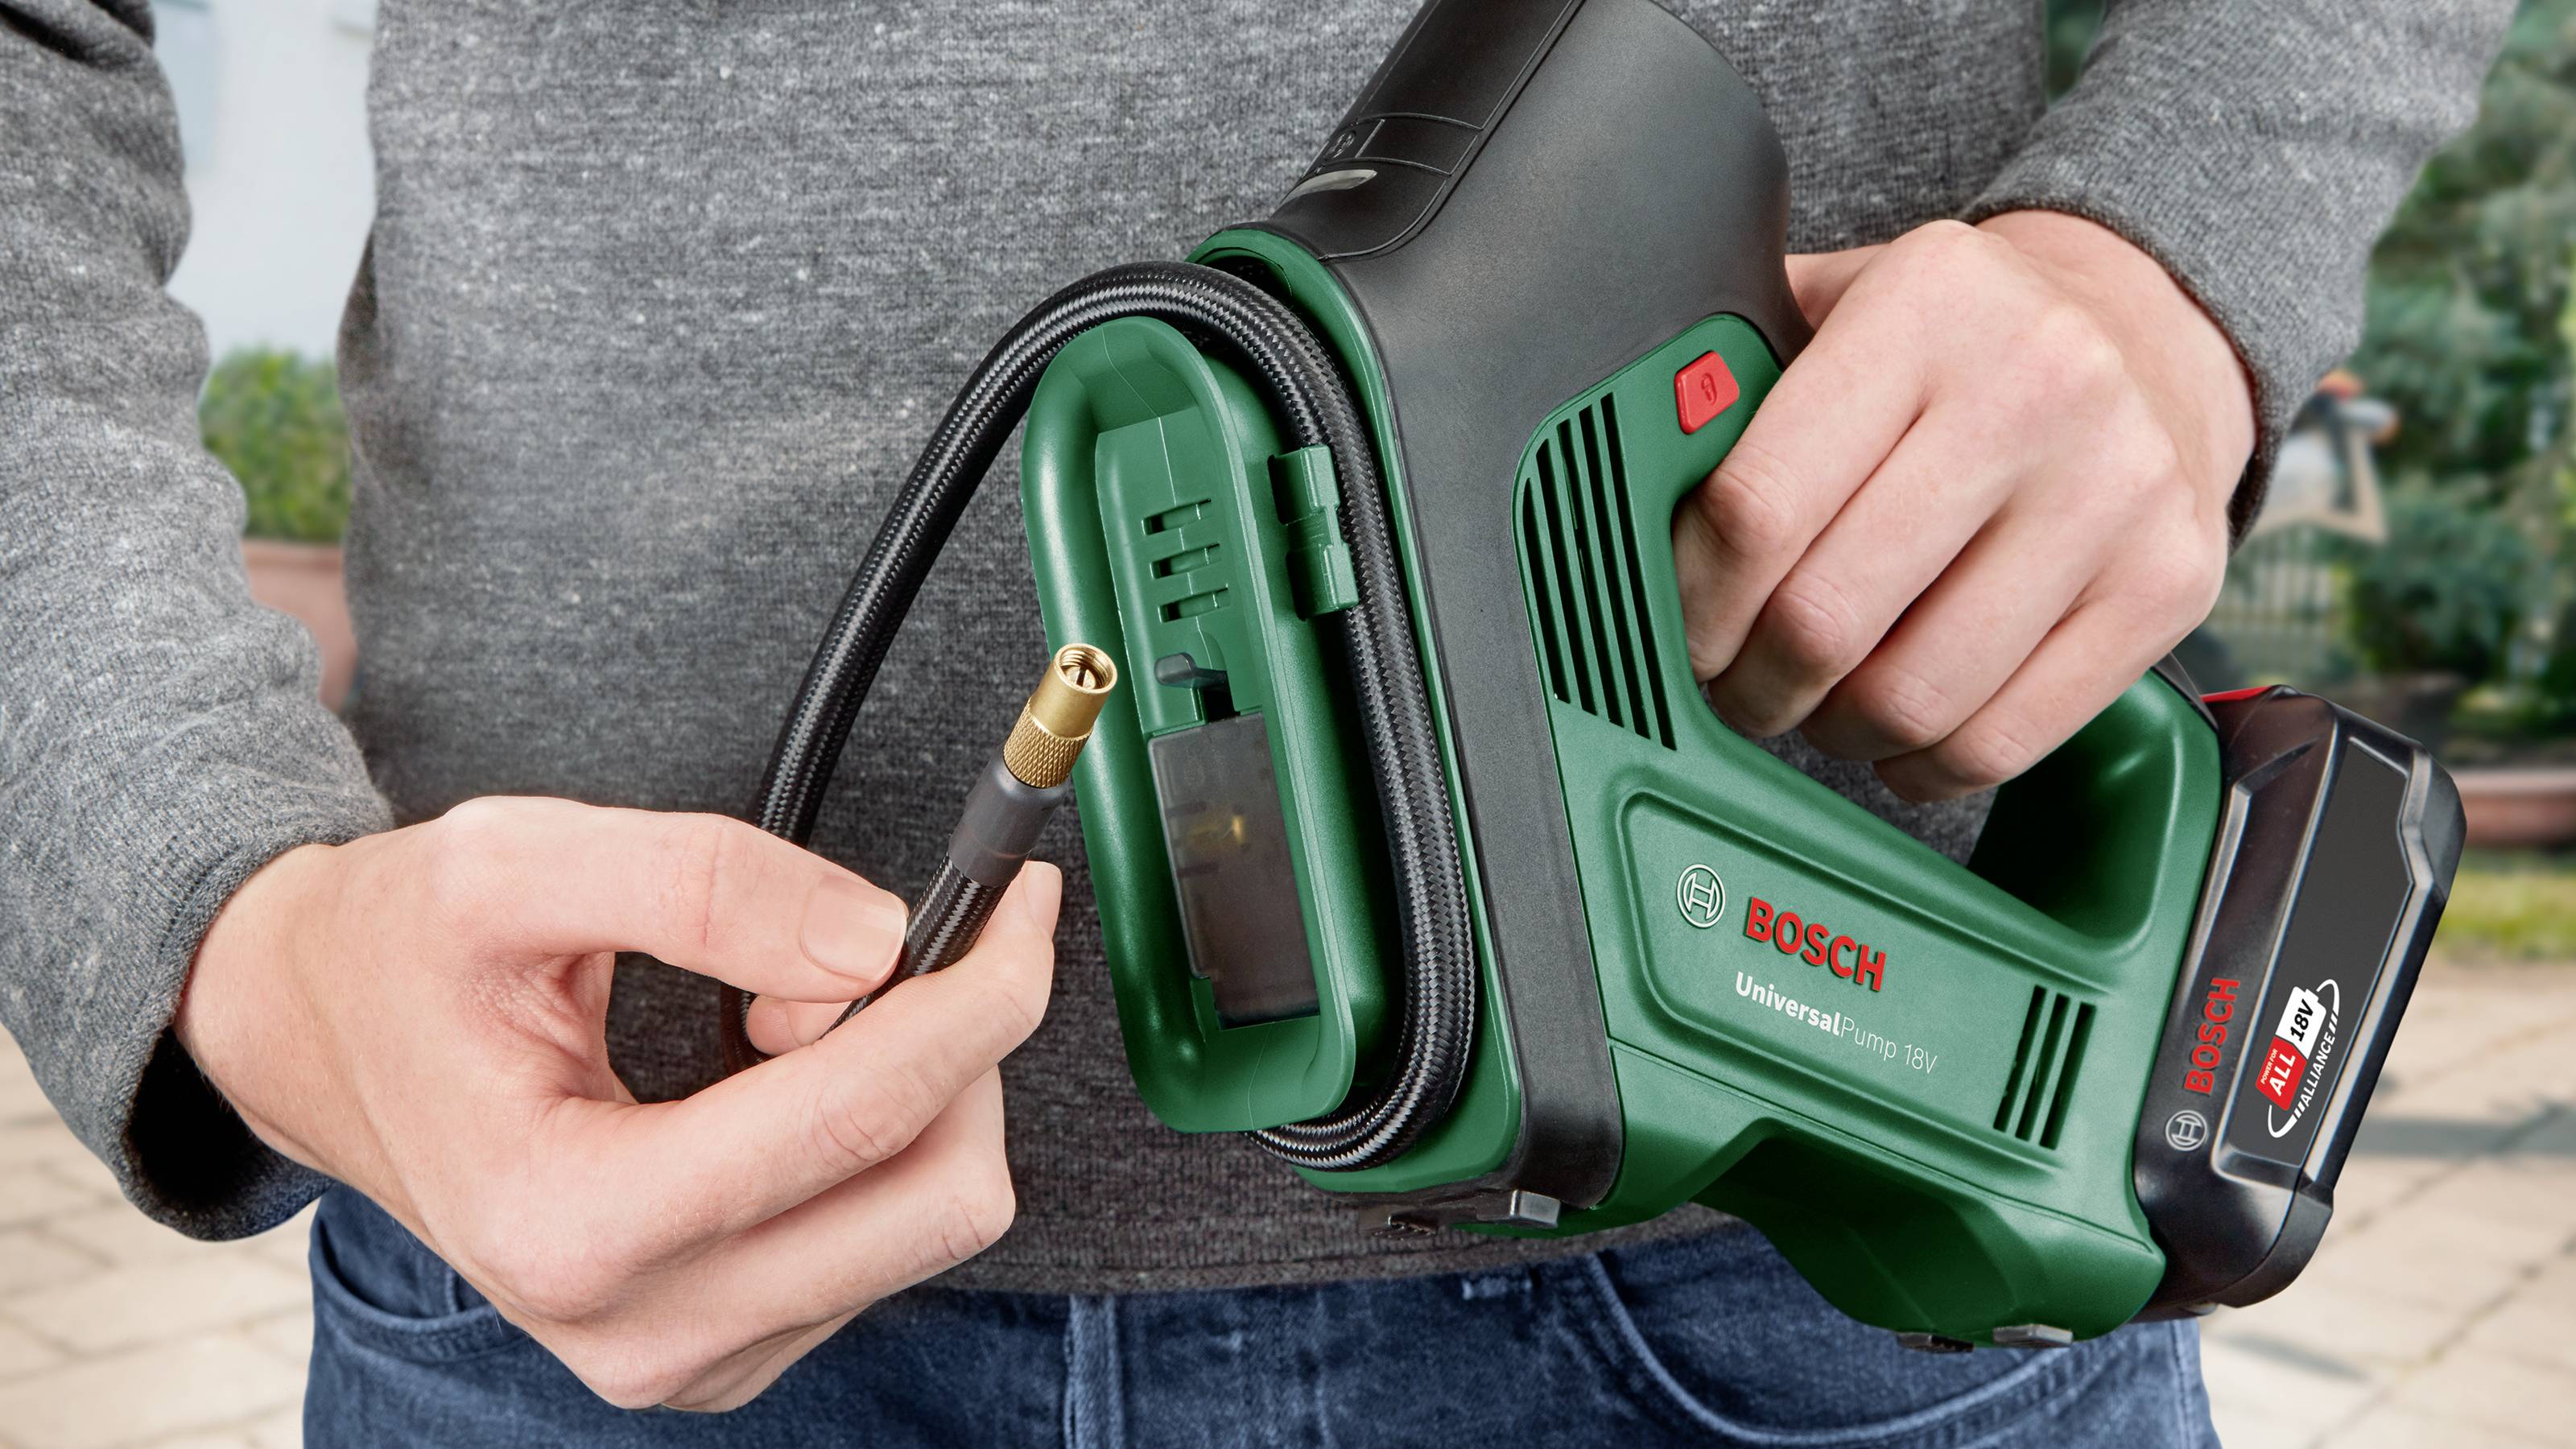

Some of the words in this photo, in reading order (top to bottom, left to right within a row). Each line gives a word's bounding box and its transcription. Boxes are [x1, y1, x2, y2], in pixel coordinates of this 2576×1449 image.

[1745, 897, 1886, 991] BOSCH
[1736, 971, 1897, 1060] UniversalPump
[1905, 1044, 1938, 1074] 18V
[2184, 978, 2240, 1094] BOSCH
[2290, 998, 2314, 1042] 18V
[2260, 1058, 2274, 1085] POWER
[2270, 1048, 2278, 1063] FOR
[2269, 1053, 2296, 1096] ALL
[2301, 1031, 2335, 1107] ALLIANCE
